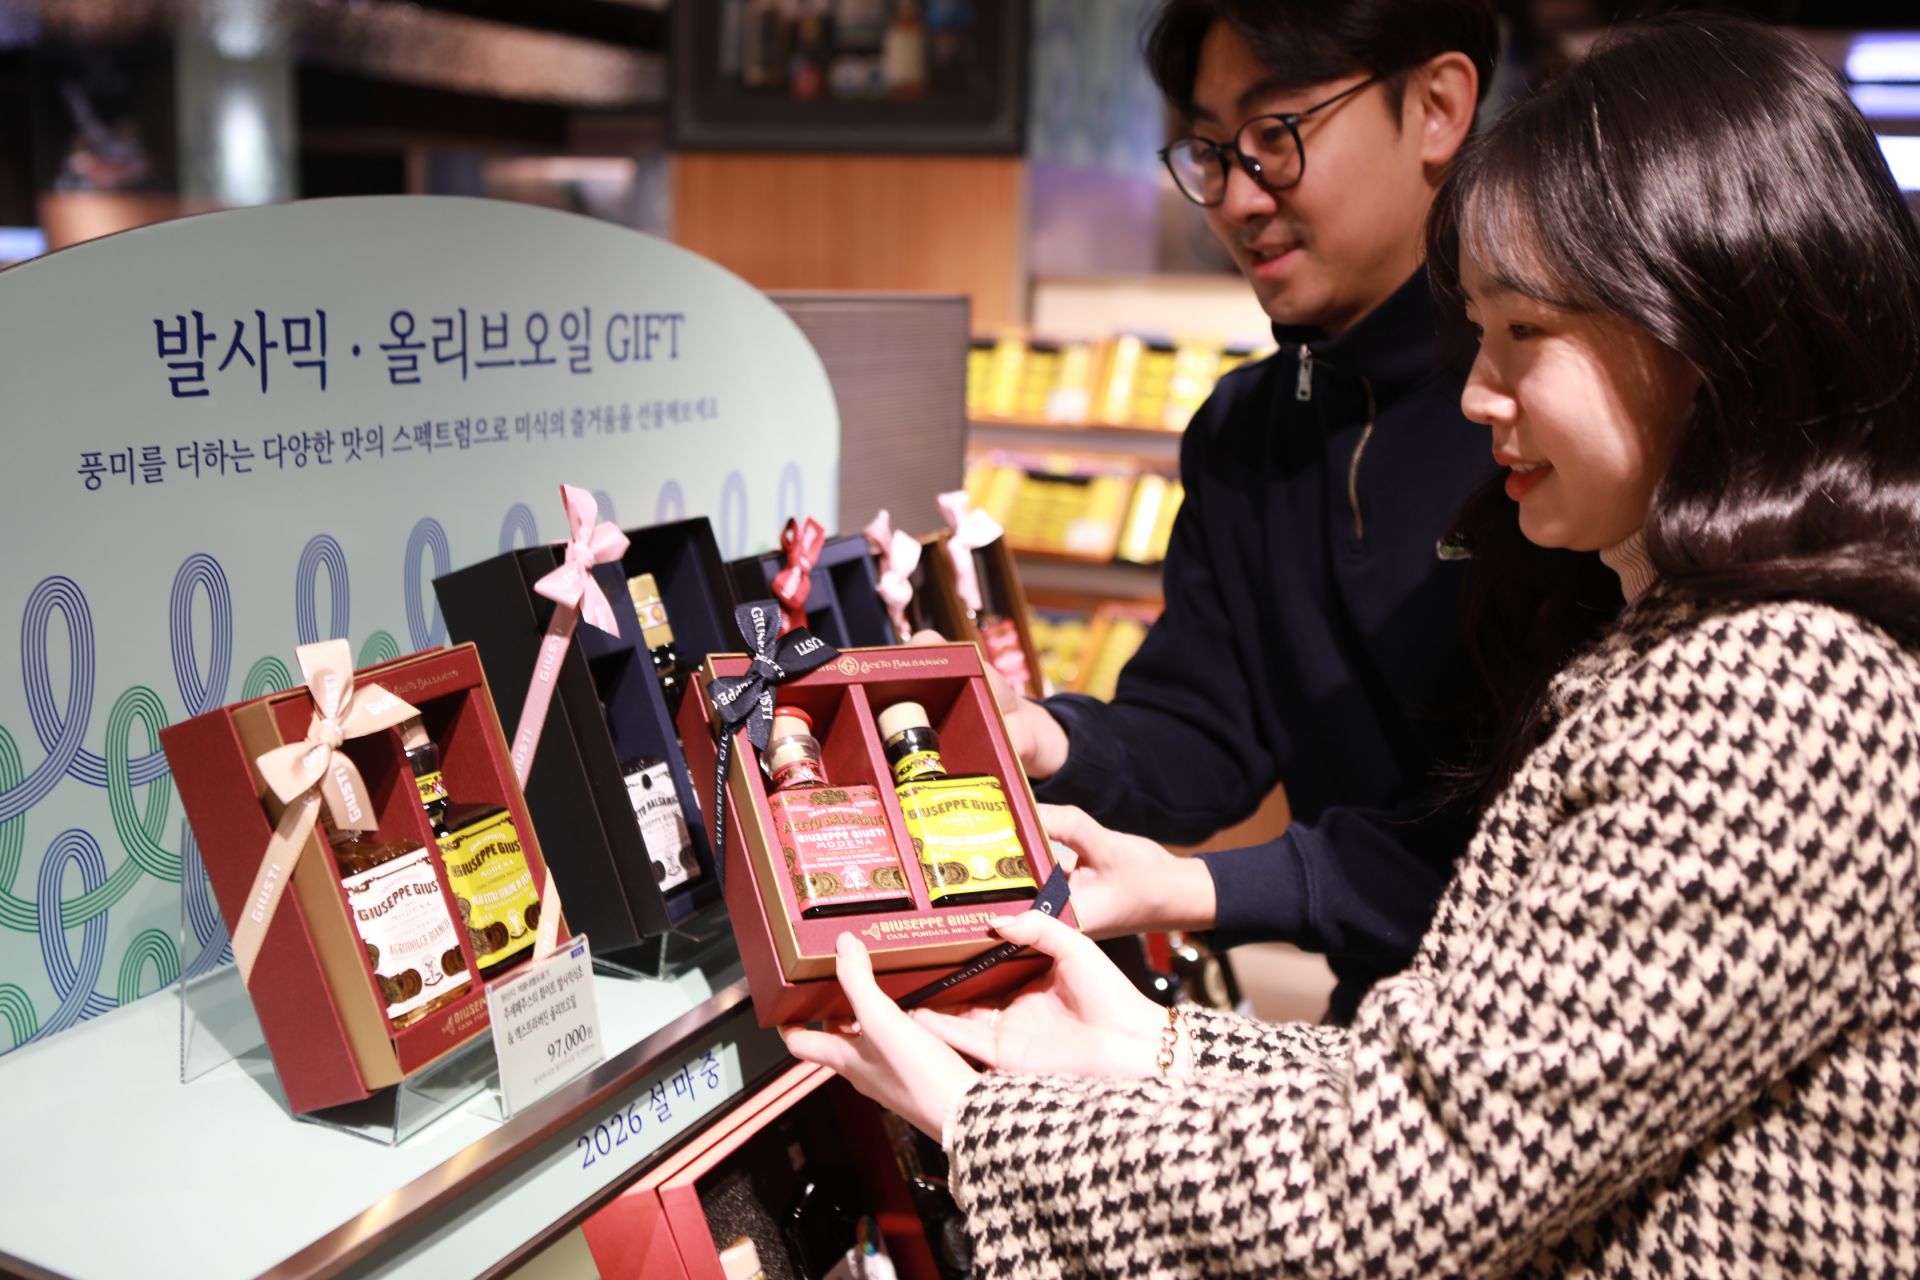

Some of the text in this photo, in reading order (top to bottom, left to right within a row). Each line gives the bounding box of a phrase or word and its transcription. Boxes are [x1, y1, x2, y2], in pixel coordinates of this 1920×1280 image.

[153, 309, 327, 398] 발사믹
[379, 307, 592, 385] 올리브오일
[606, 312, 684, 363] GIFT
[77, 445, 167, 491] 풍미를
[176, 438, 255, 479] 더하는
[263, 429, 335, 469] 다양한
[342, 424, 384, 463] 맛의
[392, 416, 510, 452] 스펙트럼으로
[515, 409, 565, 442] 미식의
[570, 404, 632, 438] 즐거움을
[795, 637, 825, 657] USTI
[719, 729, 729, 761] GIU
[334, 767, 363, 824] GIUSTI
[907, 799, 1008, 821] GIUSEPPE GIUST
[498, 840, 521, 858] GIUS
[797, 828, 887, 843] GIUSEPPE GIUSTI
[816, 839, 873, 849] MODENA
[251, 863, 282, 924] GIUSTI
[357, 884, 413, 922] GIUSEPPE
[413, 880, 438, 895] GIUS
[880, 911, 989, 933] GIUSEPPE GIUSTI
[577, 1103, 642, 1169] 2026
[650, 1049, 719, 1124] 설마중
